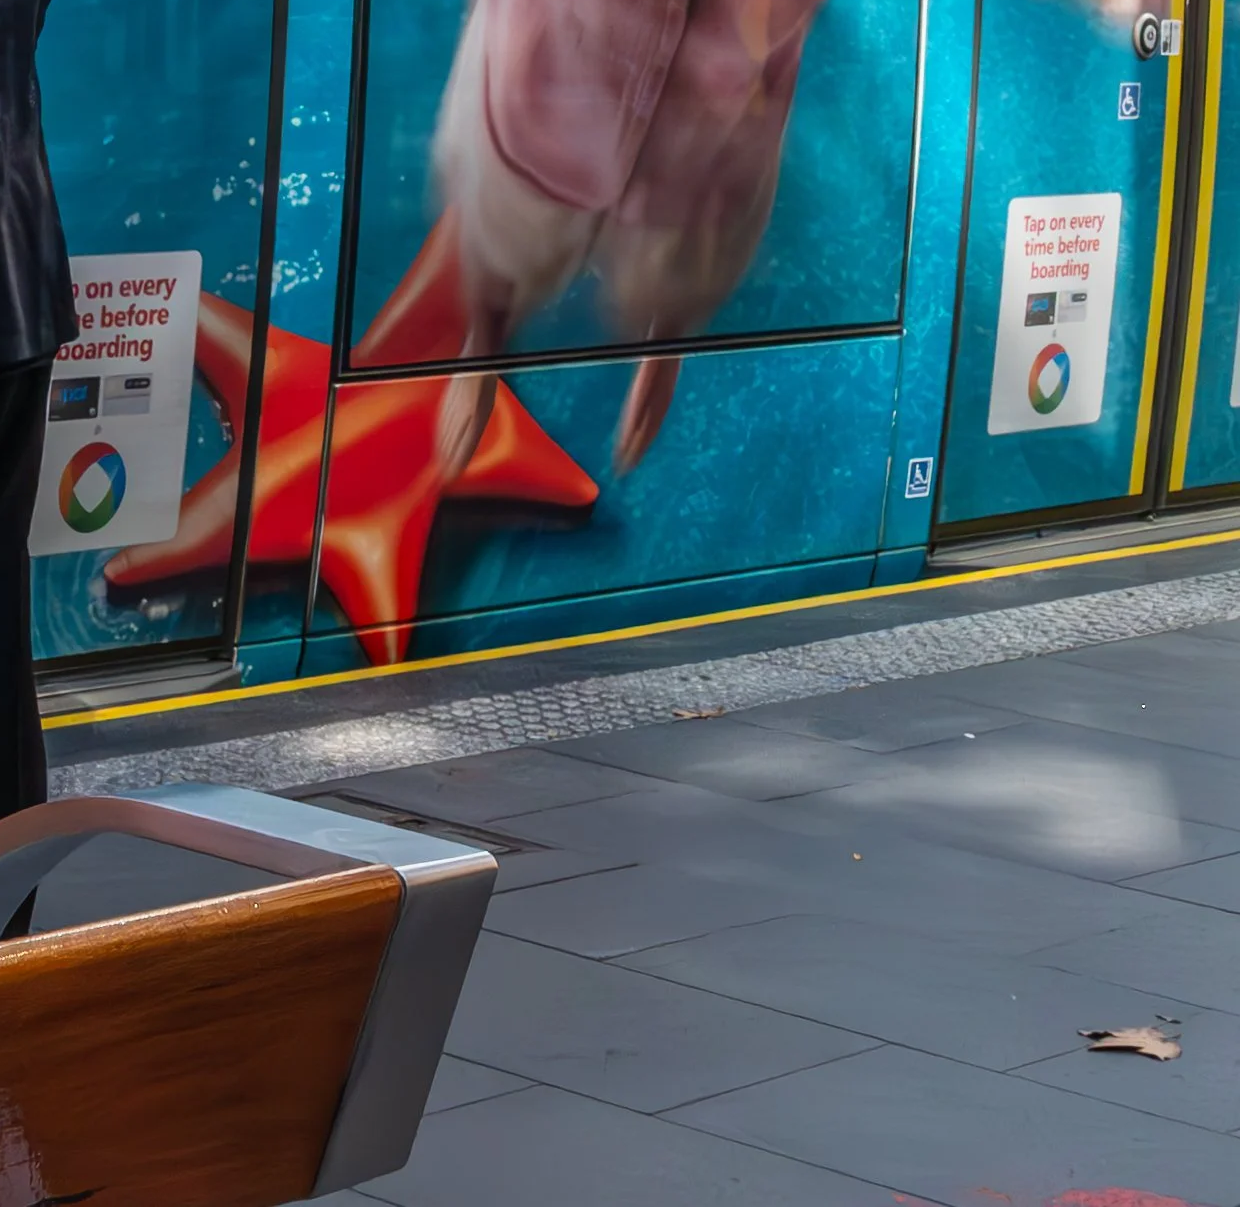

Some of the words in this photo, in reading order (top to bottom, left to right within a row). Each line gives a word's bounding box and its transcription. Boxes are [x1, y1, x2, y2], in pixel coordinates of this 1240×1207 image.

[1024, 215, 1045, 236] Tap
[1050, 216, 1066, 230] on
[1070, 214, 1105, 232] every
[1024, 237, 1054, 256] time
[1058, 234, 1099, 253] before
[1031, 258, 1089, 280] boarding
[85, 280, 112, 299] on
[119, 277, 177, 300] every
[100, 302, 169, 328] before
